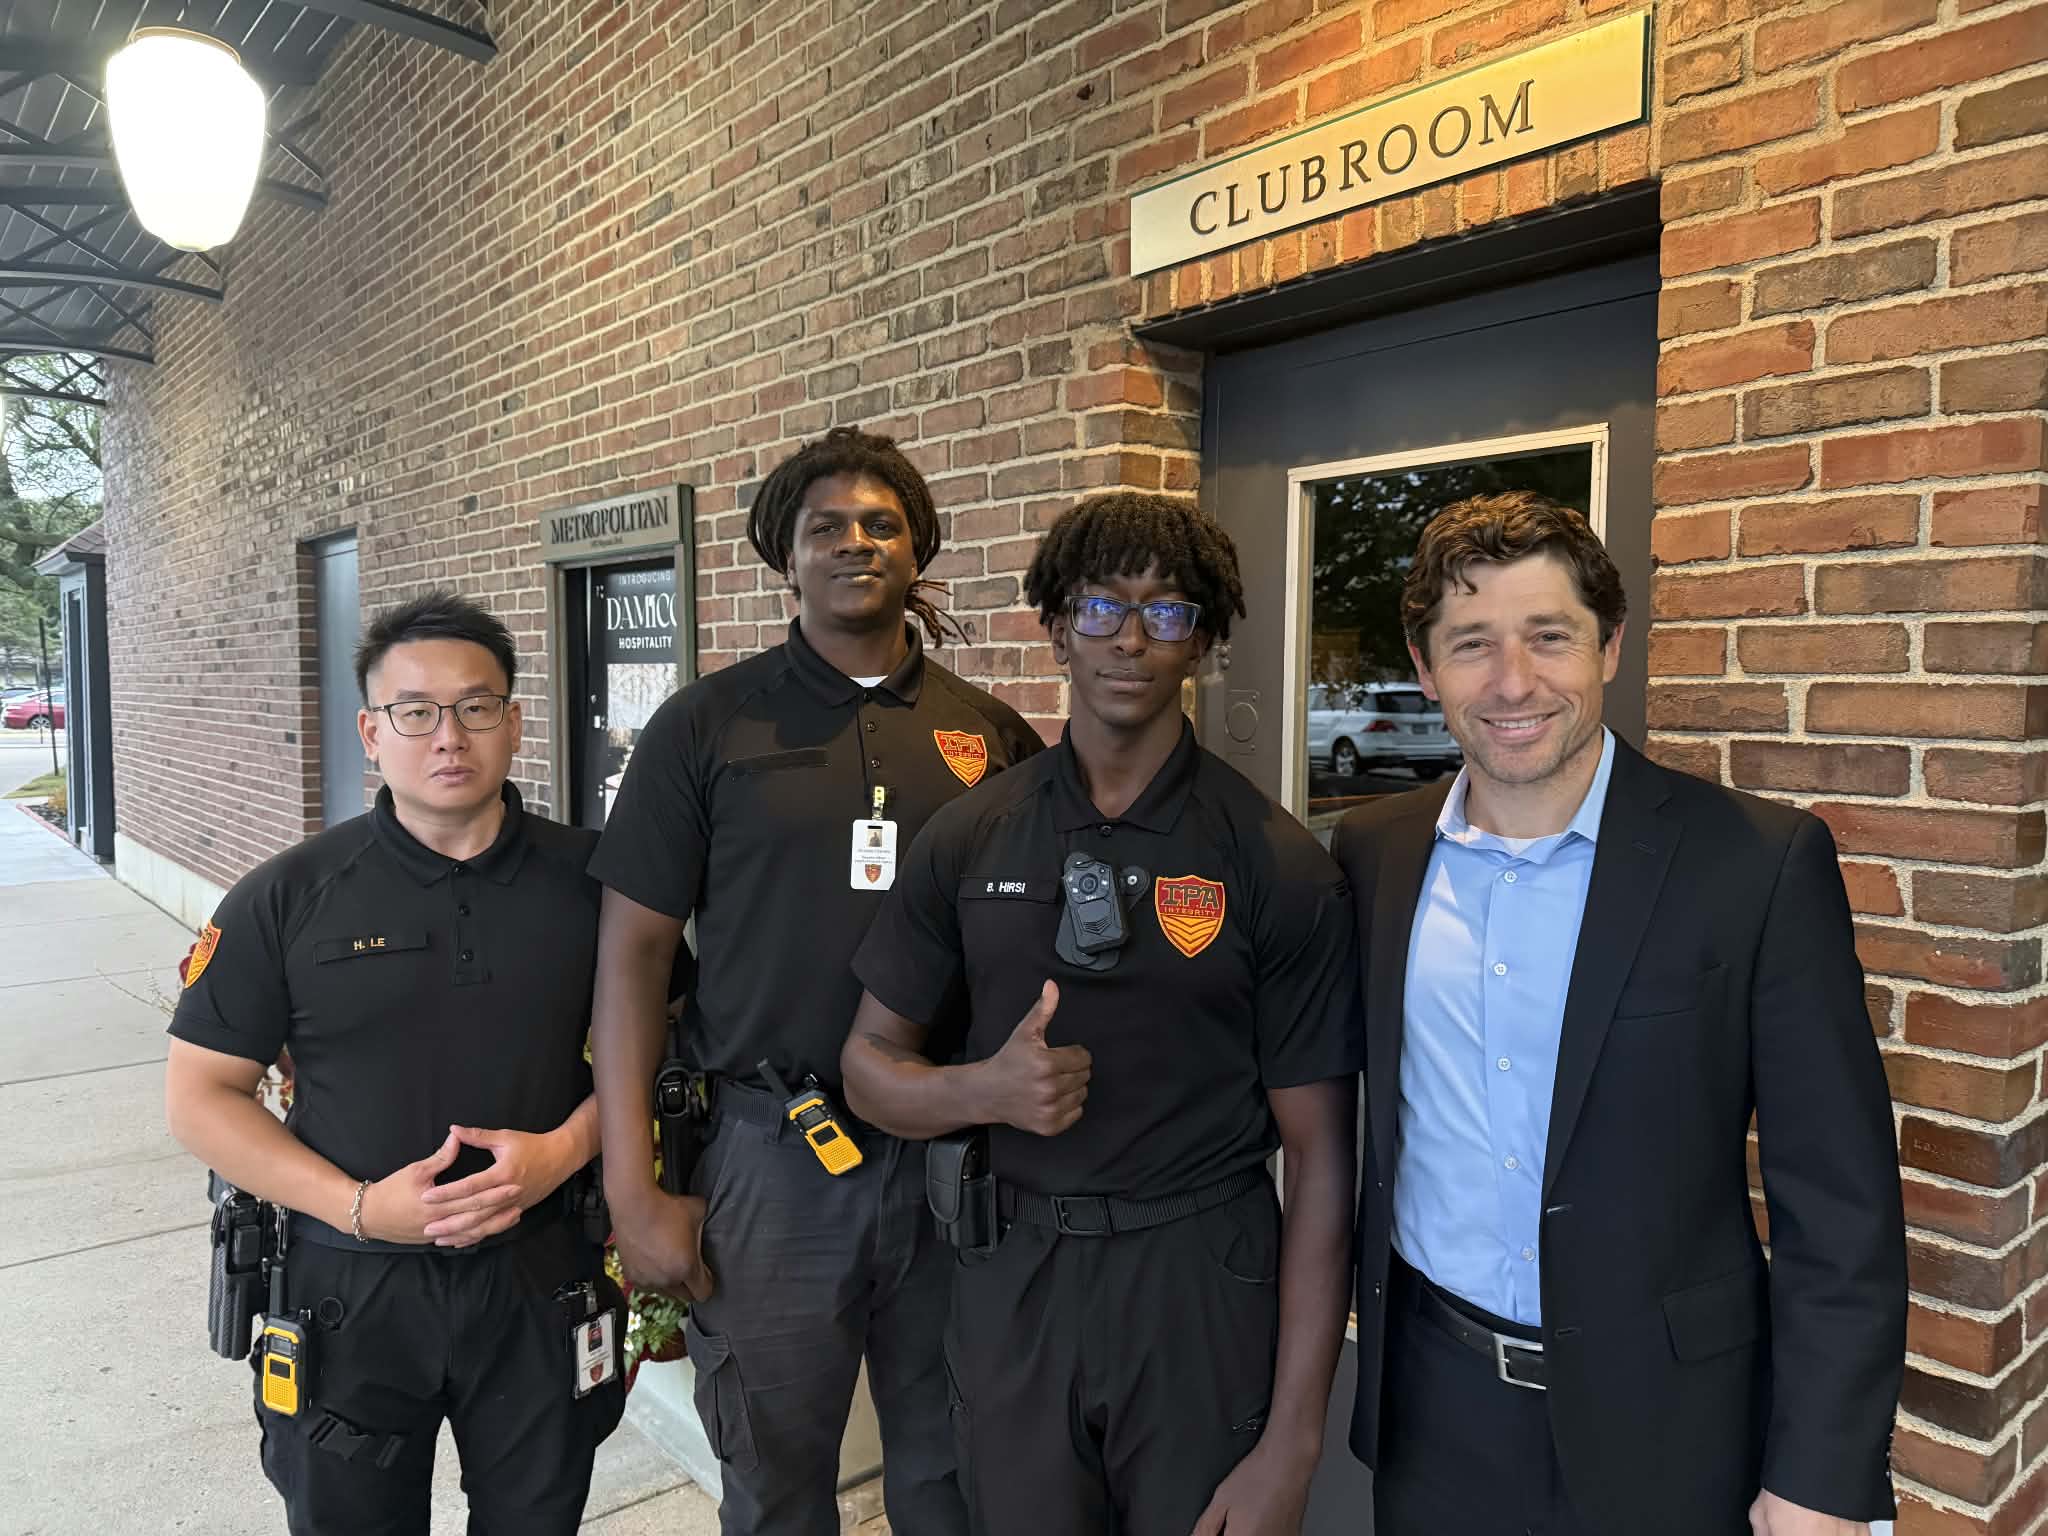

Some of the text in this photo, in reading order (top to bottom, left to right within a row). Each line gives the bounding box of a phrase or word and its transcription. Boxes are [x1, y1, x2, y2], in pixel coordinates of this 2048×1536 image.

[1189, 78, 1534, 236] CLUBROOM
[550, 496, 668, 544] METROPOLITAN
[618, 570, 671, 585] INTRODUCING
[618, 635, 672, 649] HOSPITALITY
[998, 881, 1026, 894] HIRSI
[353, 936, 385, 951] H. LE
